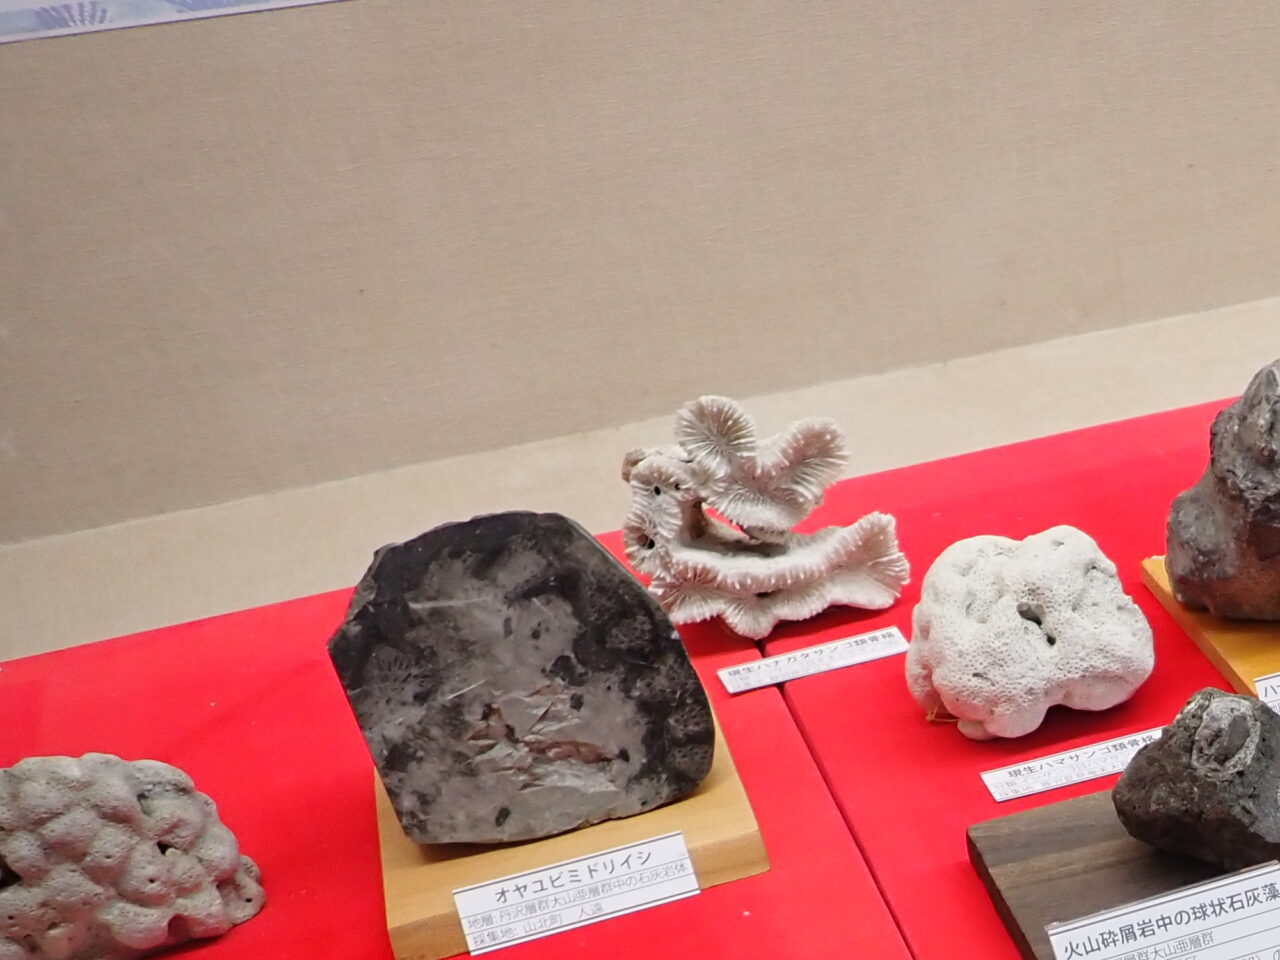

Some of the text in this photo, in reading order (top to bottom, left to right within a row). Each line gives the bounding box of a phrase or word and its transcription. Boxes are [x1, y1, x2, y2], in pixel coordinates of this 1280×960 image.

[494, 851, 652, 904] オヤユビミドリイシ
